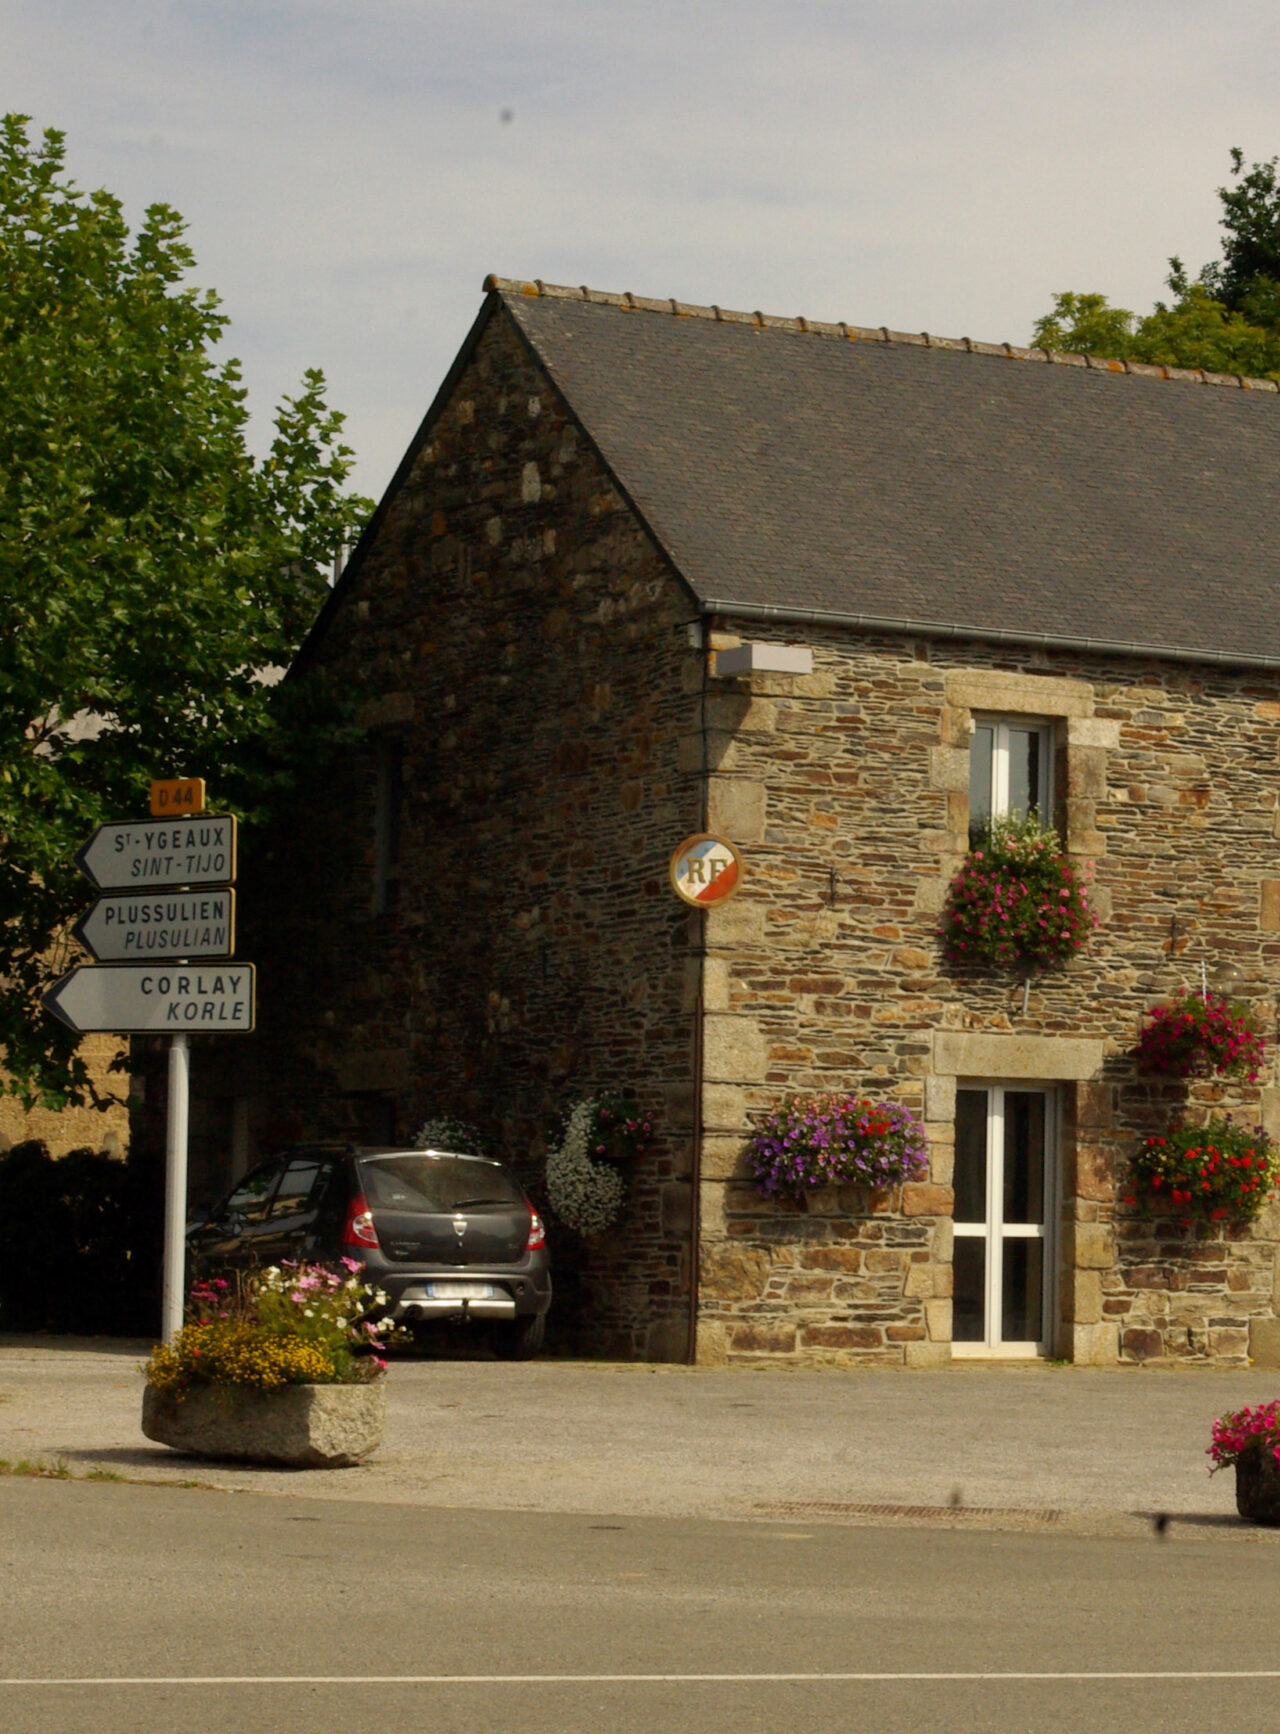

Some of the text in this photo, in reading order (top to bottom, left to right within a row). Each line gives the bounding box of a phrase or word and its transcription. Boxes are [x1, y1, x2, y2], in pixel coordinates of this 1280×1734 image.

[131, 854, 225, 877] SINT-TIJO
[687, 857, 728, 884] RF
[105, 901, 224, 925] PLUSSULIEN
[125, 927, 225, 950] PLUSULIAN
[141, 976, 242, 995] CORLAY
[167, 1002, 244, 1020] KORLE
